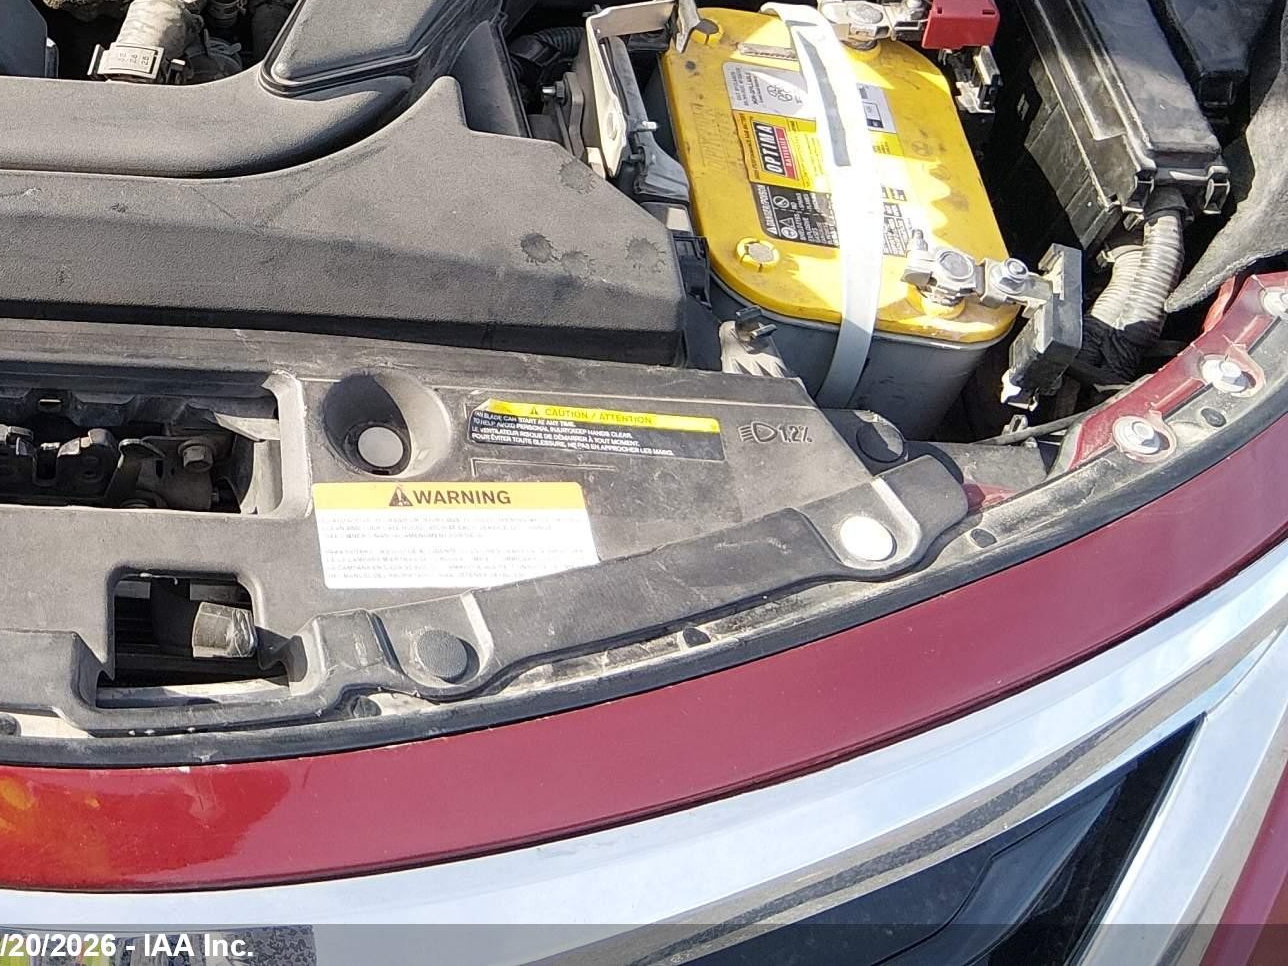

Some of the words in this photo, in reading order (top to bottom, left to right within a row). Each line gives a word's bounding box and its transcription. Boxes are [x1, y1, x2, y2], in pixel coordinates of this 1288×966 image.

[756, 124, 784, 173] OPTIMA
[545, 408, 588, 419] CAUTION
[600, 412, 652, 424] ATTENTION
[412, 490, 512, 505] WARNING
